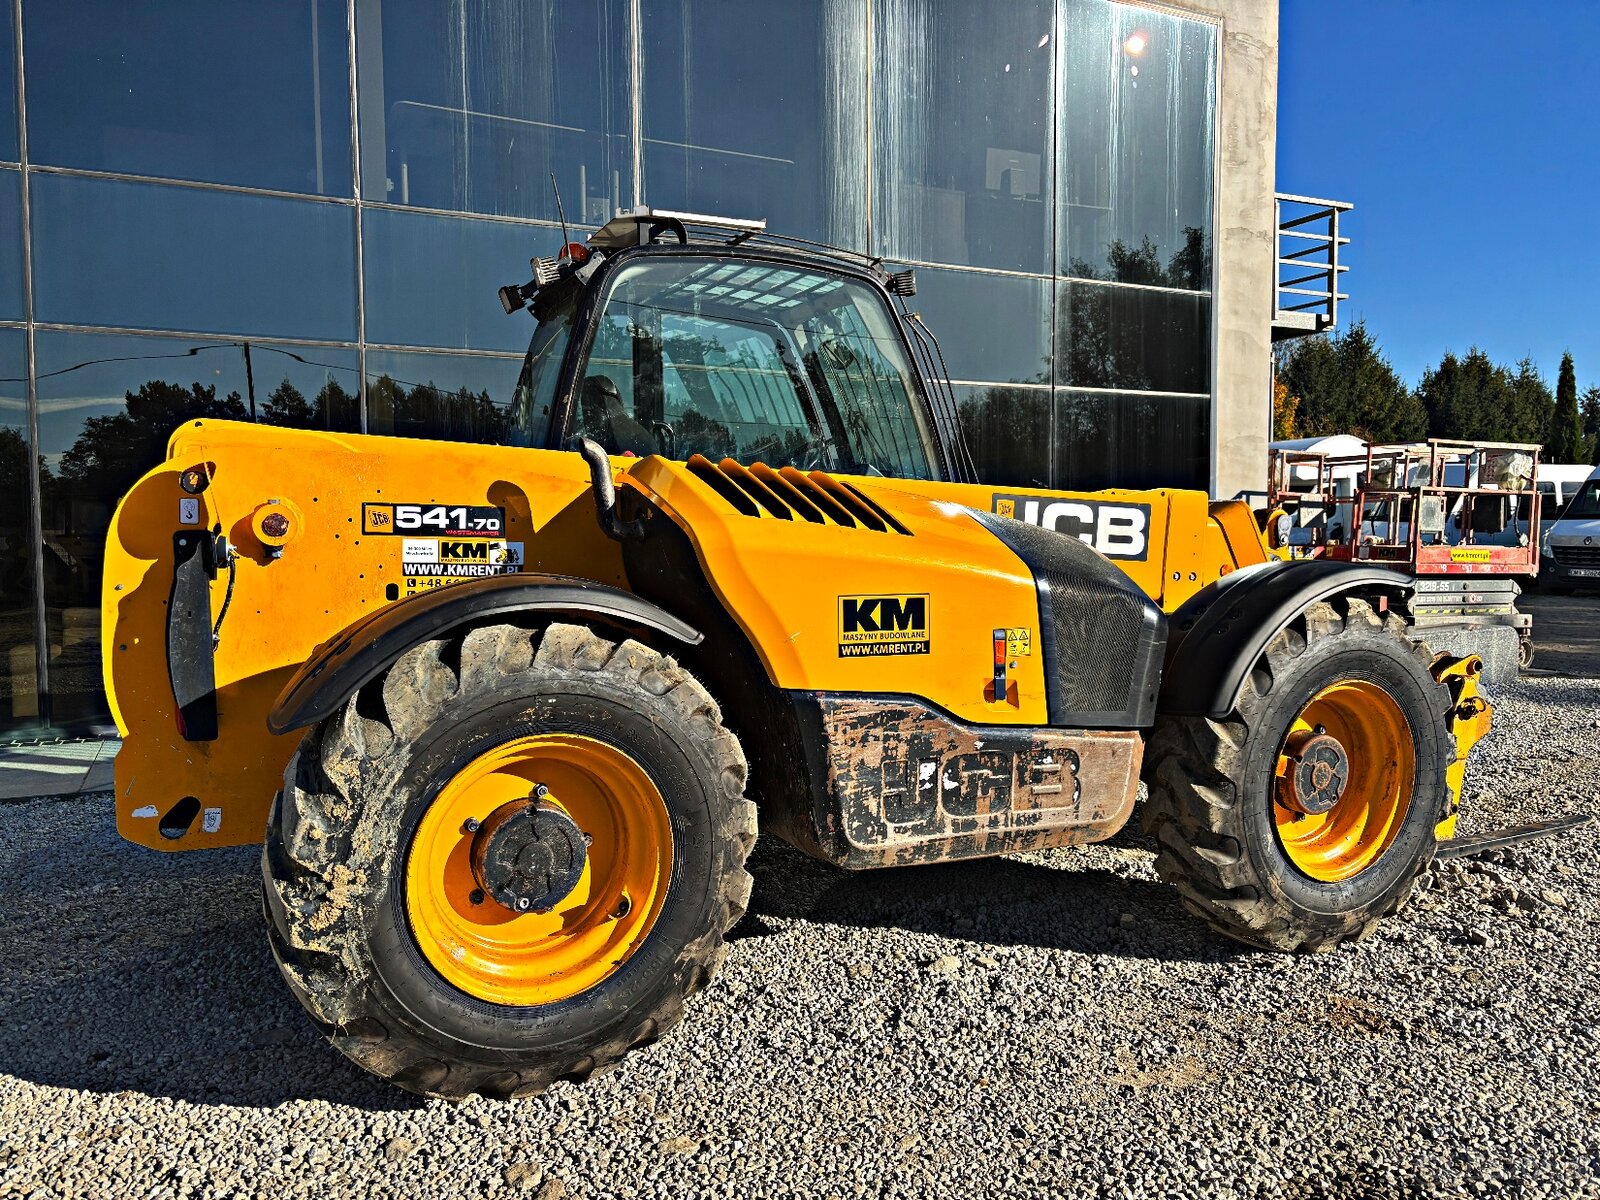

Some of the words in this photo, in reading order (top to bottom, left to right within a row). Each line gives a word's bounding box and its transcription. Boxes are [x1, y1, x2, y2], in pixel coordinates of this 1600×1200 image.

[371, 511, 391, 527] JCB
[441, 541, 487, 559] KM
[842, 598, 925, 632] KM
[842, 632, 879, 641] MASZYNY
[880, 631, 926, 640] BUDOWLANE
[841, 643, 926, 655] WWW.KMRENT.PL
[881, 747, 1081, 826] JCB
